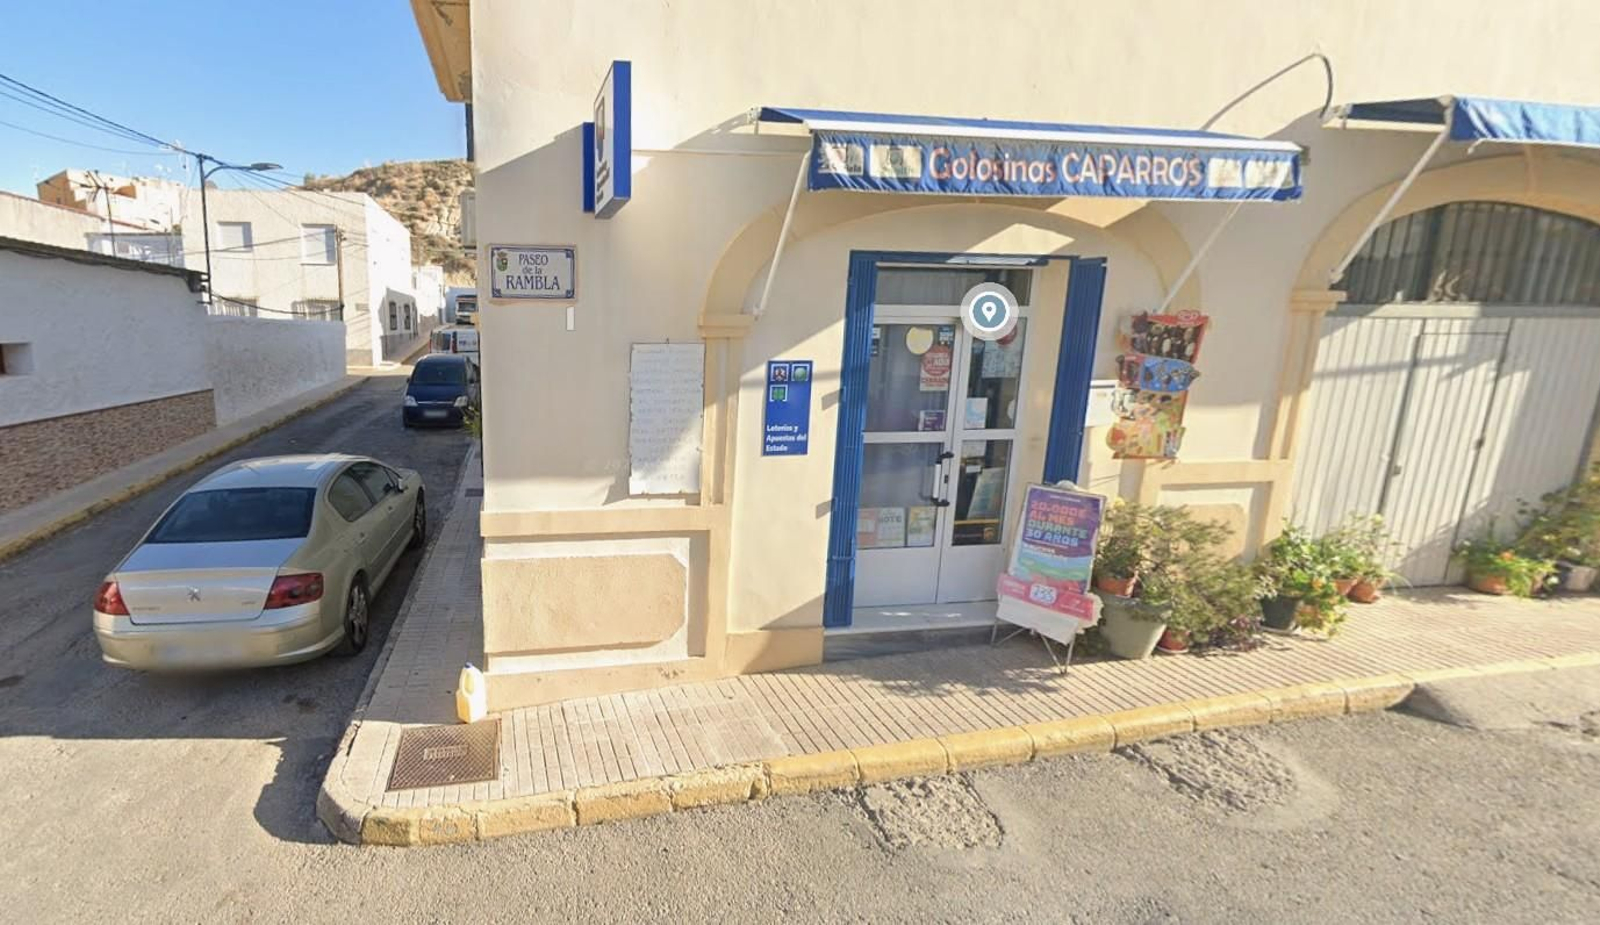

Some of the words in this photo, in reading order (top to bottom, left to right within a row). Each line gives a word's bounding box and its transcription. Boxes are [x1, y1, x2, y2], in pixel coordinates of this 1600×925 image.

[929, 147, 1056, 184] Golosinas
[518, 253, 549, 266] PASEO
[522, 265, 533, 275] de
[534, 265, 543, 275] la
[505, 274, 560, 291] RAMBLA
